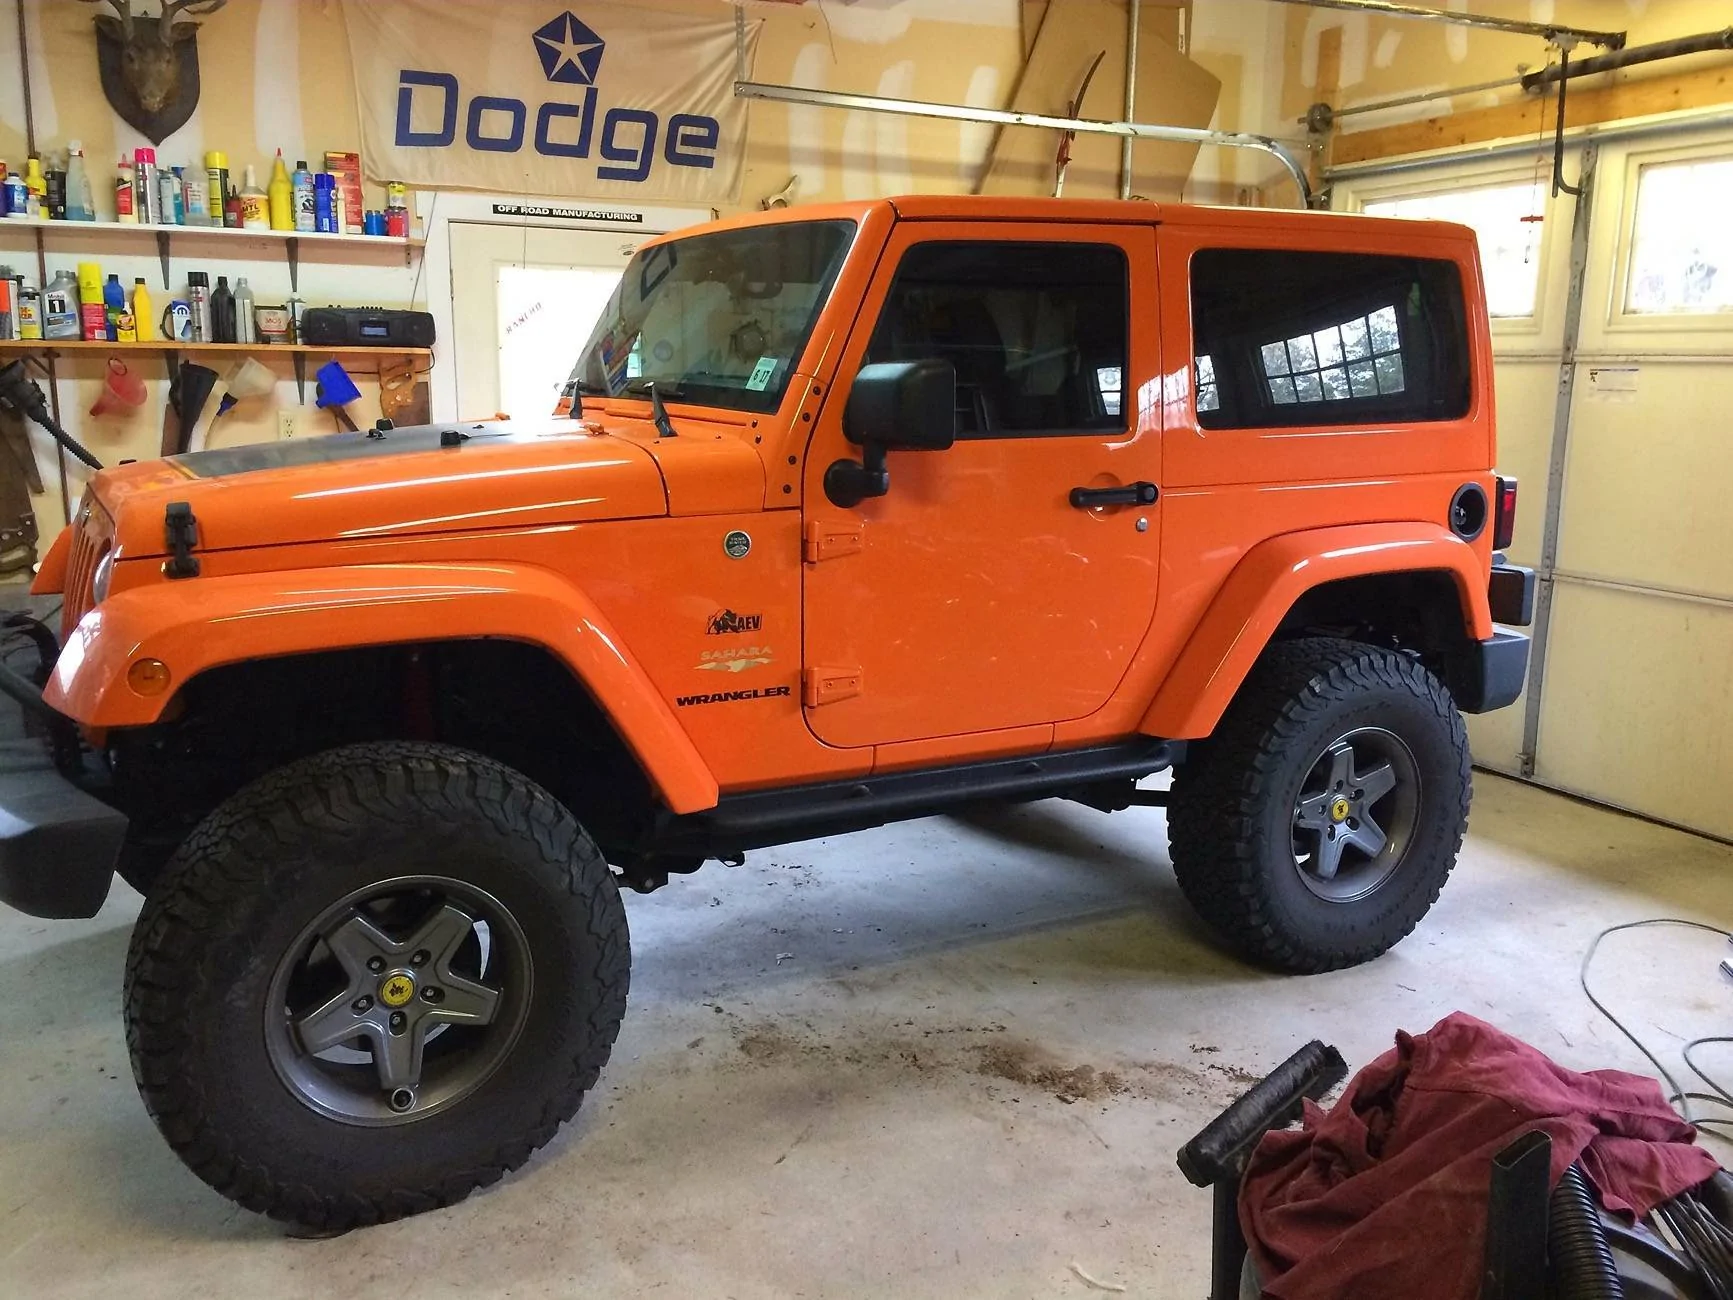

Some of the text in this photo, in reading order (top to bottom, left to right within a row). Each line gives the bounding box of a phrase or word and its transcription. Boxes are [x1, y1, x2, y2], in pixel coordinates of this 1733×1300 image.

[395, 70, 720, 182] Dodge
[497, 205, 638, 221] OFF ROAD MANUFACTURING
[52, 300, 61, 313] 1
[737, 615, 761, 630] AEV
[700, 646, 773, 660] SAHARA
[676, 686, 791, 707] WRANGLER
